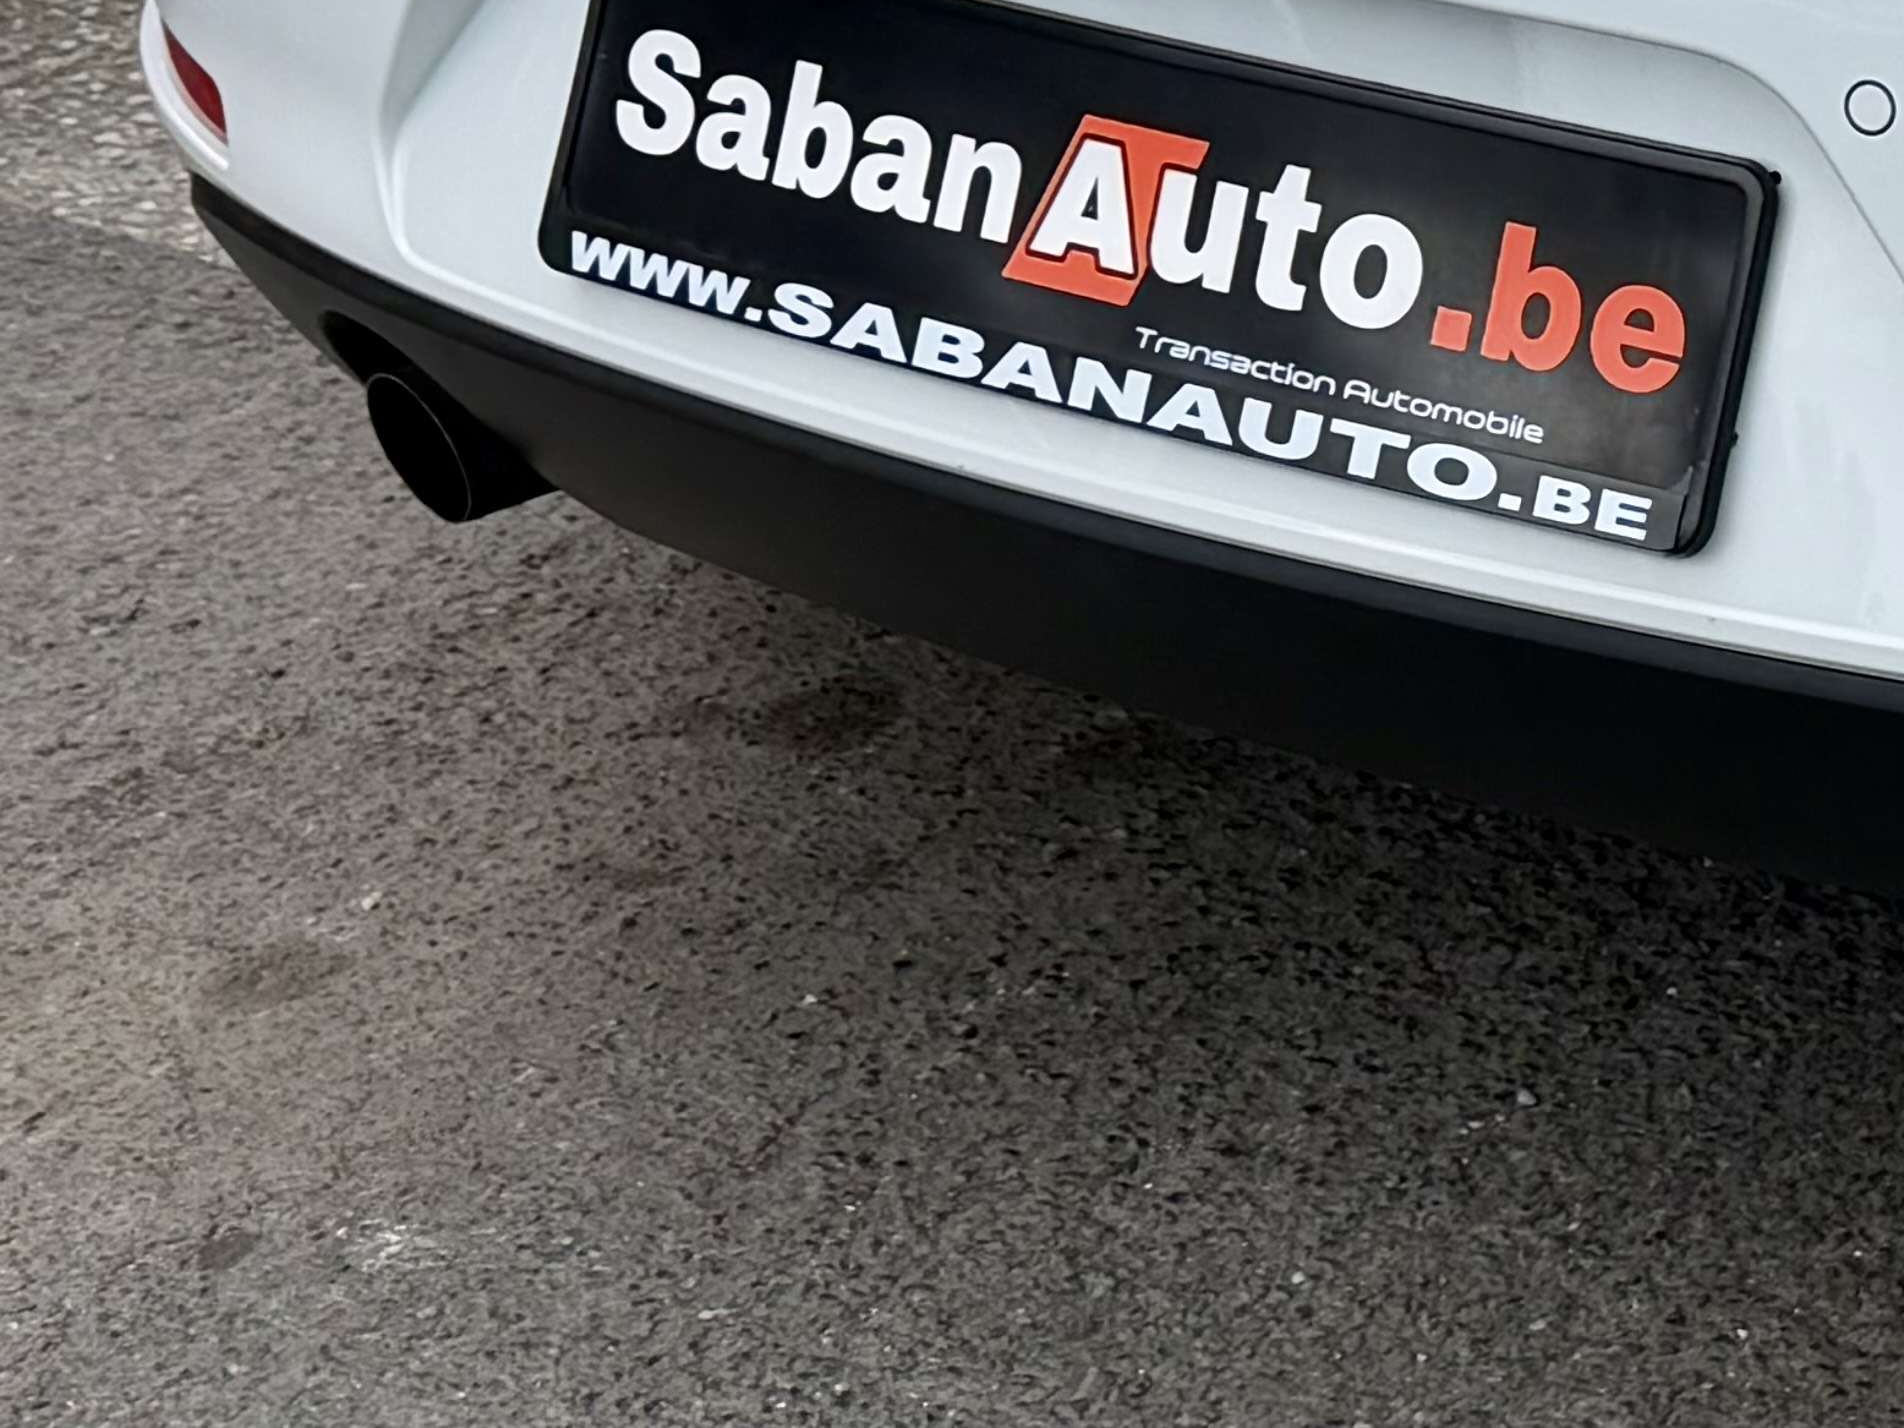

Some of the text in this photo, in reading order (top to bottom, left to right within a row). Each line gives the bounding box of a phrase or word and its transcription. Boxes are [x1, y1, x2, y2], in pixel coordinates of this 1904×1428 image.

[570, 229, 1653, 541] www.SABANAUTO.BE
[1135, 326, 1545, 444] Transaction Automobile
